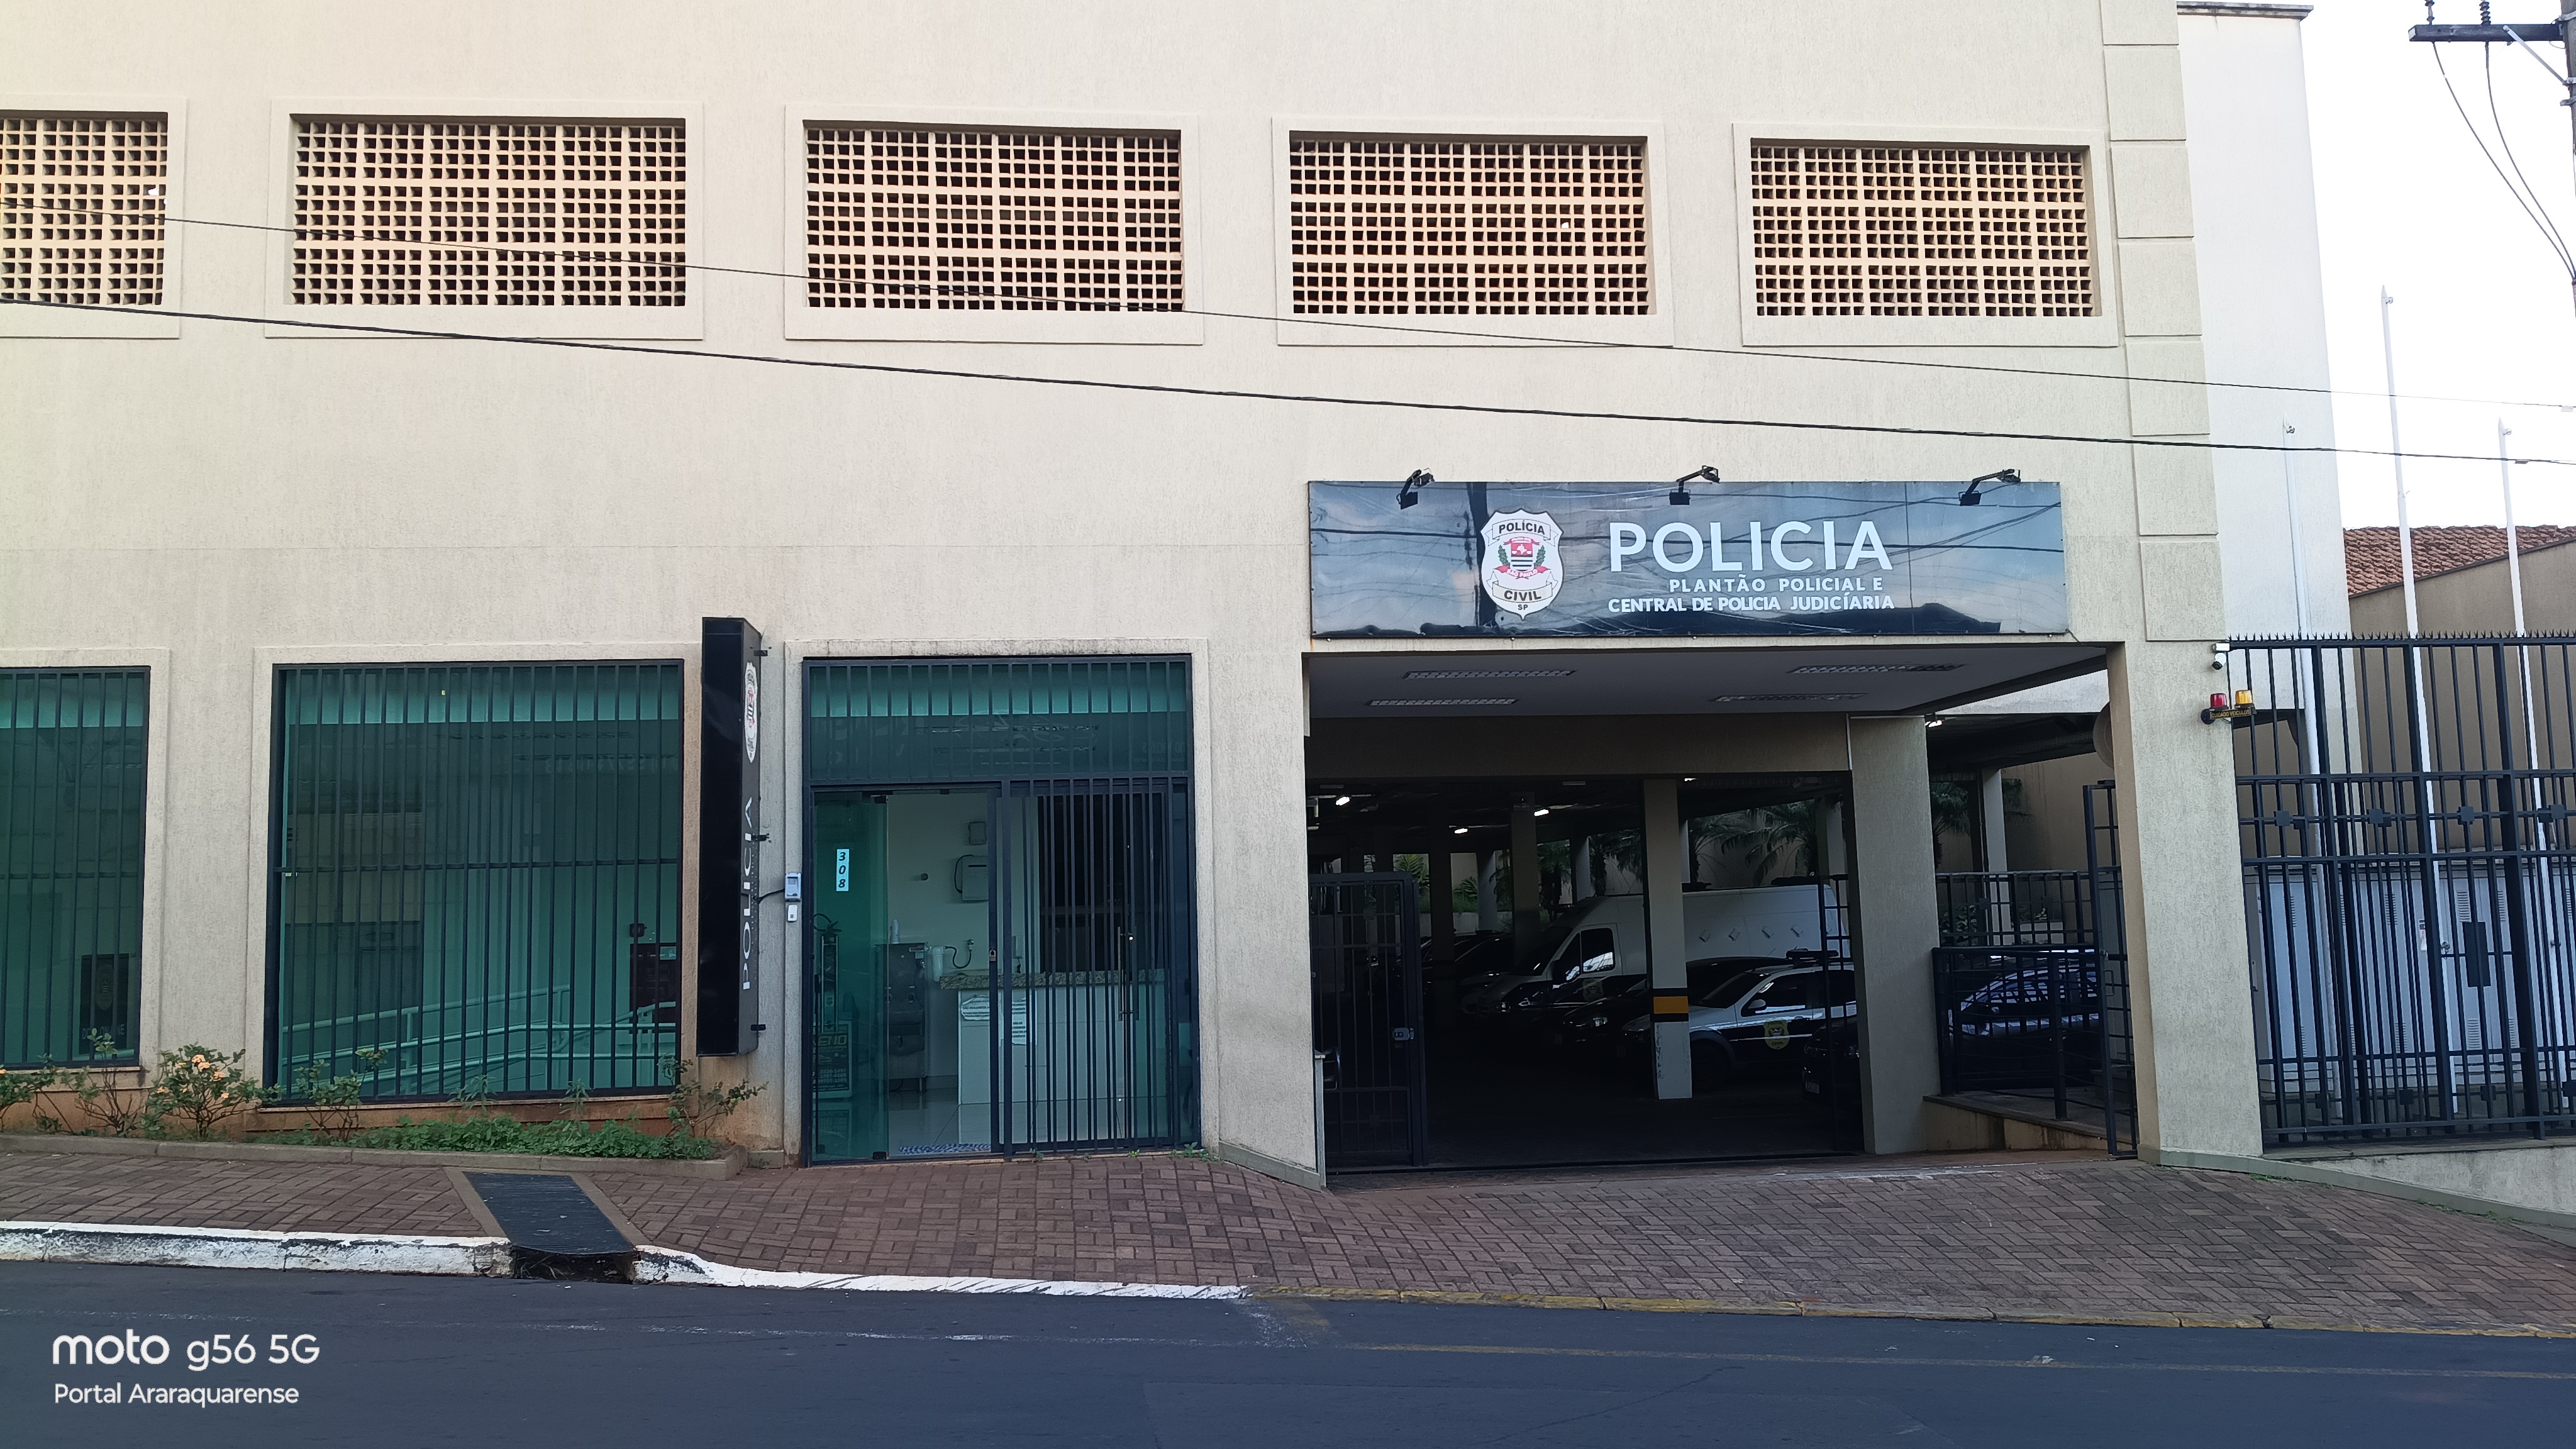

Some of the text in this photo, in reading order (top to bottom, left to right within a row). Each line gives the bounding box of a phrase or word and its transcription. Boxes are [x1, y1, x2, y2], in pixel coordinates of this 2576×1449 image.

[1499, 520, 1545, 535] POLÍCIA
[1609, 521, 1893, 572] POLICIA
[1670, 574, 1883, 592] PLANTÃO POLICIAL E
[1504, 590, 1541, 601] CIVIL
[1608, 592, 1895, 613] CENTRAL DE POLICIA JUDICÍARIA
[838, 852, 847, 888] 308
